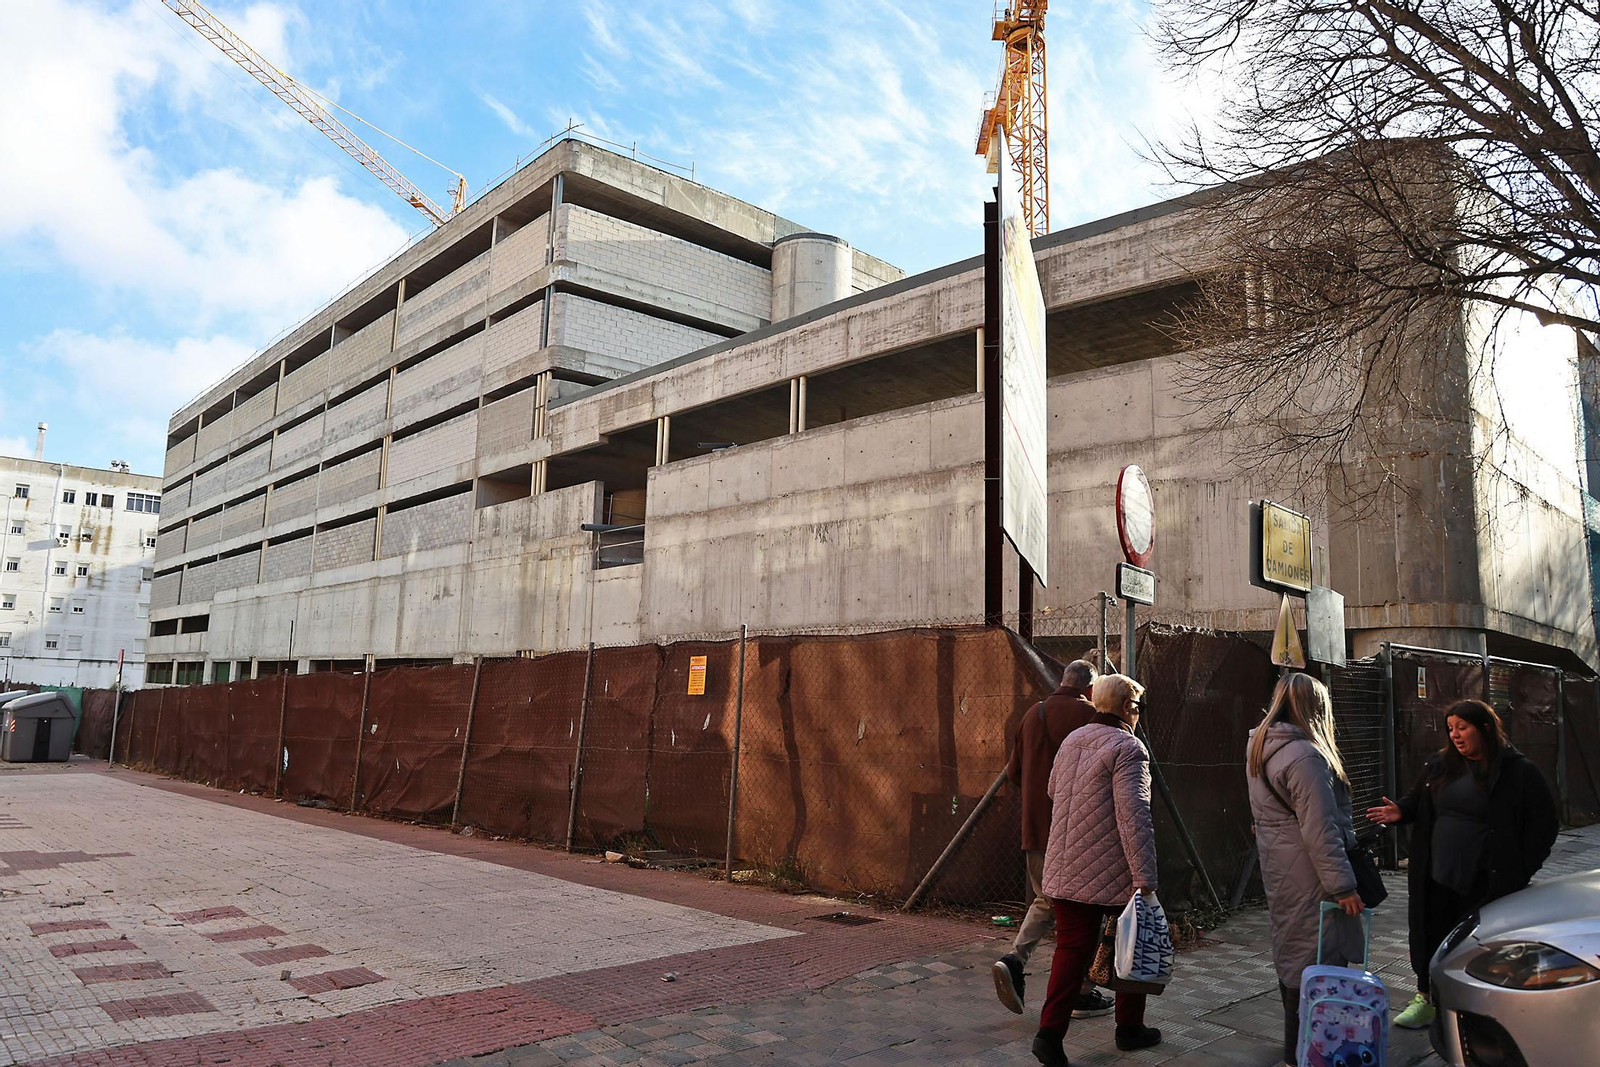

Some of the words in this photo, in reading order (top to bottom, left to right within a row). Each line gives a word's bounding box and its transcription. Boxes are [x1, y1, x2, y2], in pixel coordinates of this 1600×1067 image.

[1273, 513, 1302, 535] SALIDA
[1282, 539, 1294, 555] DE
[1266, 557, 1310, 582] CAMIONES
